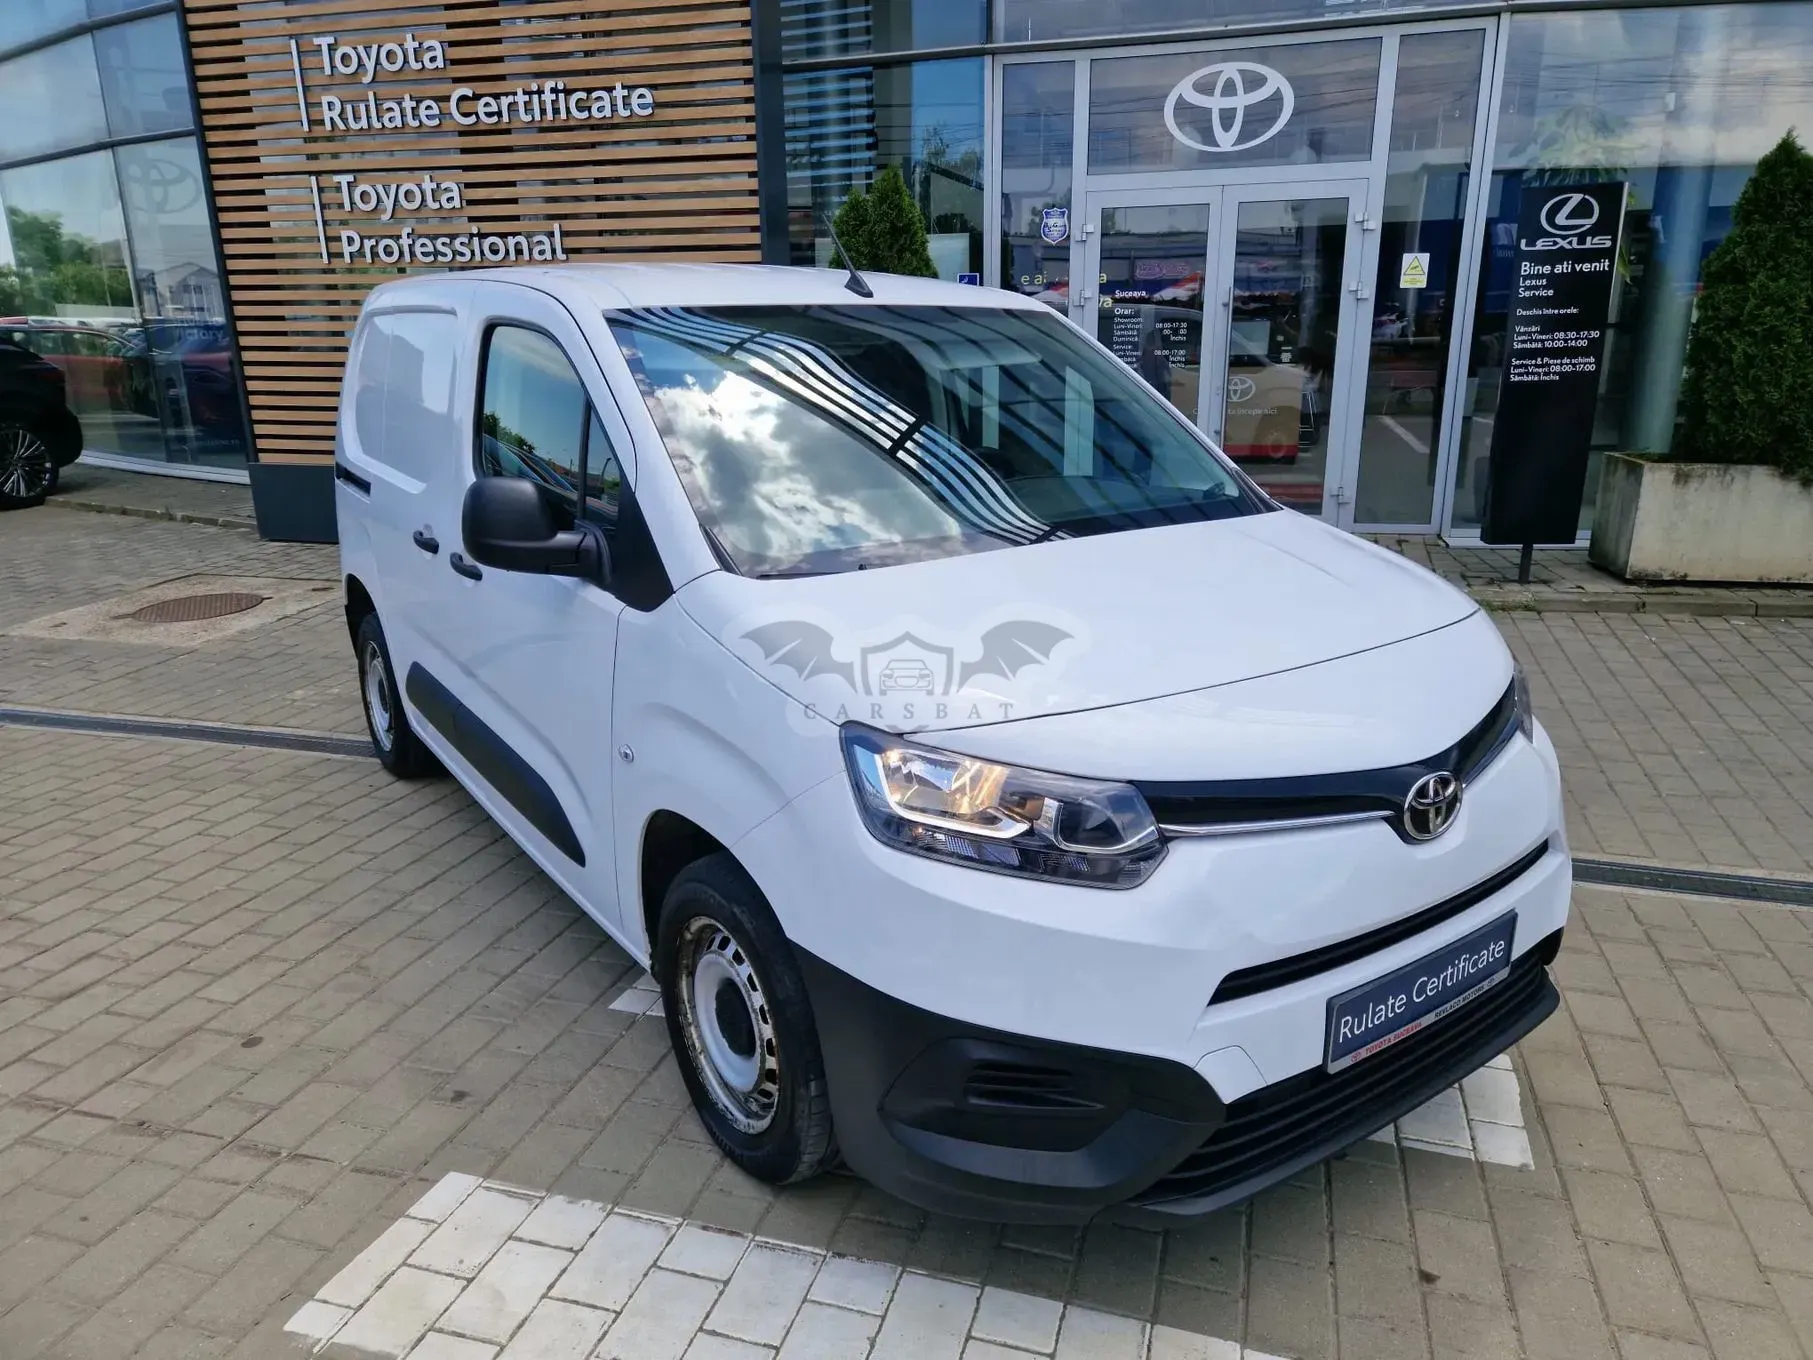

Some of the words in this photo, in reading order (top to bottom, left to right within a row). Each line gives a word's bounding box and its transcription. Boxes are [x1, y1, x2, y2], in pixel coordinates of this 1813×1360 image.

[313, 33, 446, 84] Toyota
[320, 91, 441, 133] Rulate
[449, 81, 655, 126] Certificate
[333, 174, 463, 221] Toyota
[340, 223, 568, 264] Professional
[1520, 235, 1612, 251] LEXUS
[1521, 261, 1551, 275] Bine
[1553, 260, 1572, 274] ati
[1574, 259, 1610, 272] venit
[1519, 277, 1547, 287] Lexus
[1115, 289, 1147, 298] Suceava
[1518, 287, 1554, 297] Service
[1516, 308, 1542, 316] Deschis
[1559, 306, 1579, 314] orele:
[1553, 331, 1600, 339] 08:30-17:30
[1571, 356, 1595, 364] schimb
[1550, 364, 1596, 372] 08:00-17:00
[1540, 372, 1560, 380] Închis
[1338, 993, 1407, 1043] Rulate
[1412, 940, 1505, 1003] Certificate
[1365, 1037, 1392, 1055] TOYOTA
